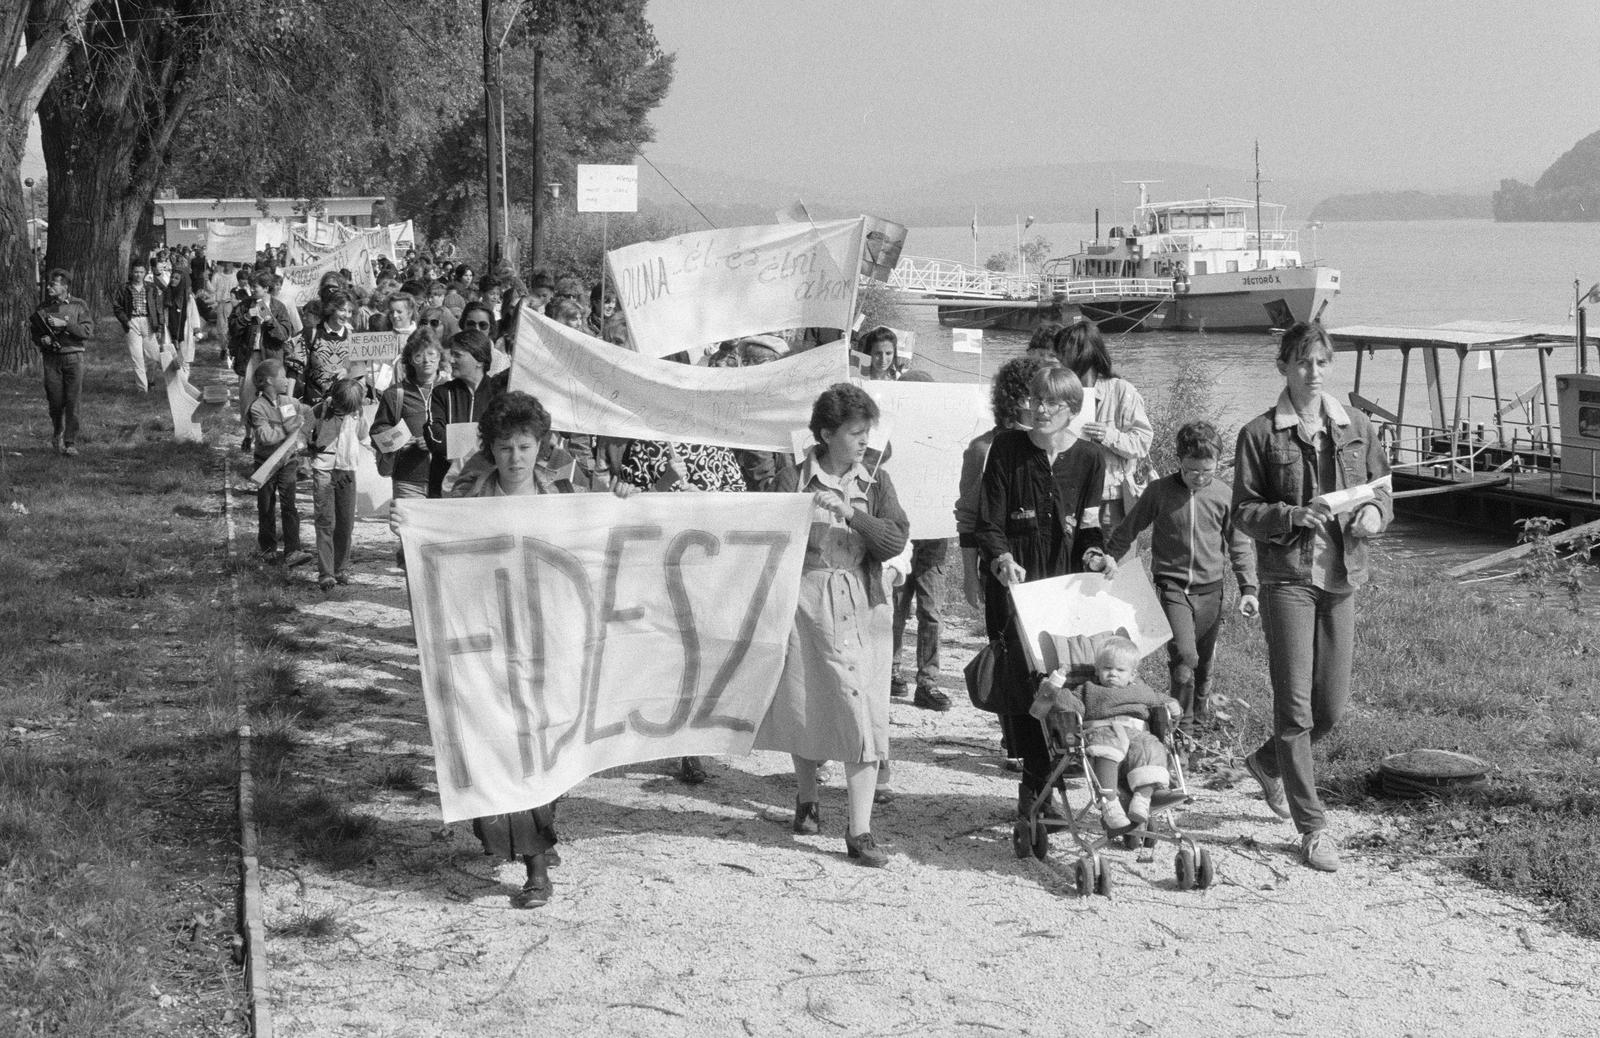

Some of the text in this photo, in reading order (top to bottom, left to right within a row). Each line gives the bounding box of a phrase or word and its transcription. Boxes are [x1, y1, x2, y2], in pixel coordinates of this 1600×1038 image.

[351, 336, 361, 344] NE
[351, 346, 359, 357] A
[420, 525, 792, 790] FIDESZ
